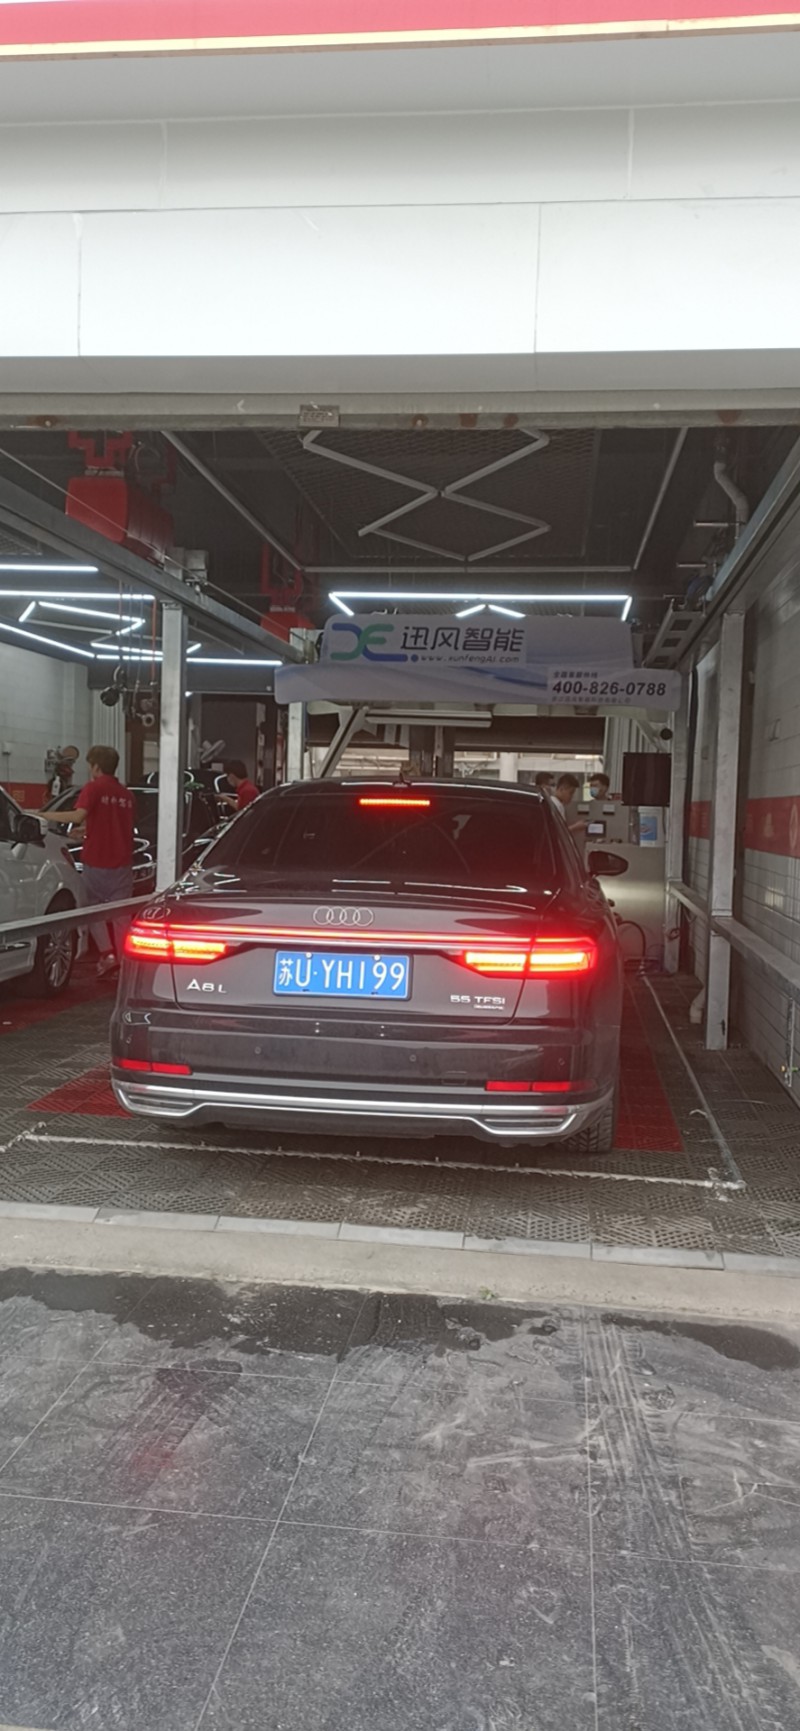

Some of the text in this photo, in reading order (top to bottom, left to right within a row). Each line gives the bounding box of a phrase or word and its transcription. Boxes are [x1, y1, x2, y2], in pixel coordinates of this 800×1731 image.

[401, 625, 525, 652] 迅风智能
[552, 681, 666, 696] 400-826-0788
[186, 978, 227, 993] A8 L
[450, 994, 505, 1004] 55 TFSI
